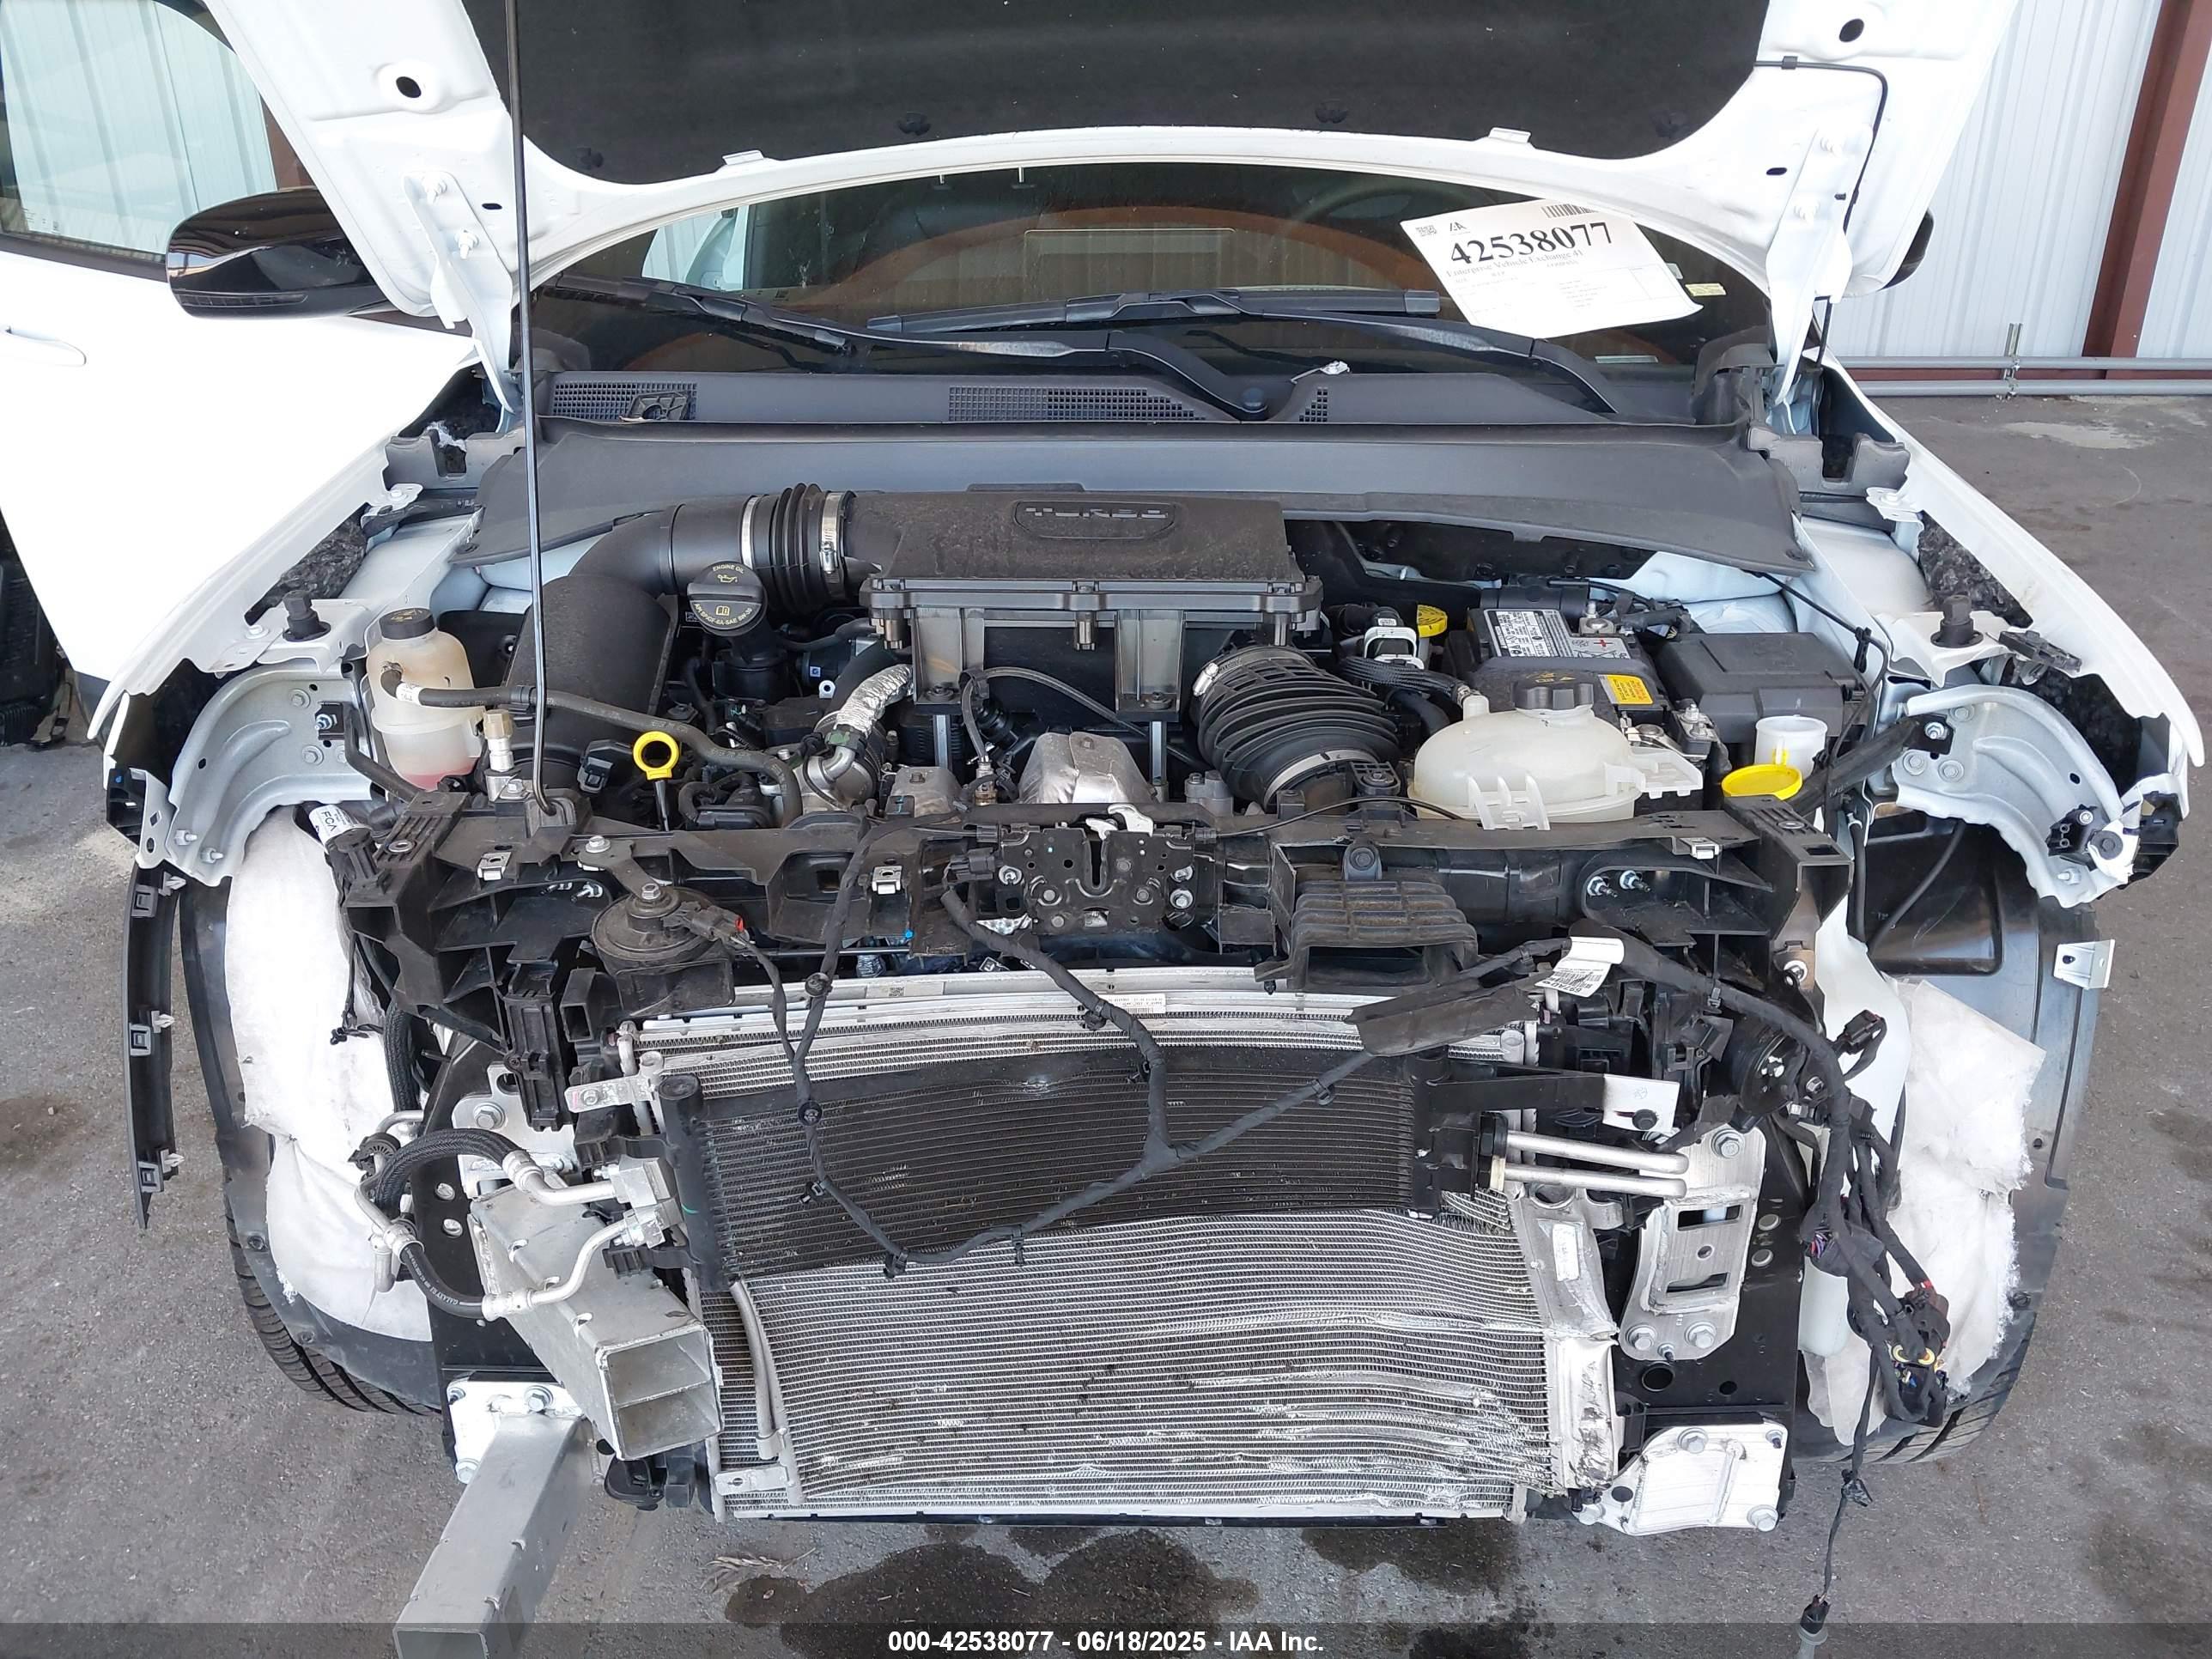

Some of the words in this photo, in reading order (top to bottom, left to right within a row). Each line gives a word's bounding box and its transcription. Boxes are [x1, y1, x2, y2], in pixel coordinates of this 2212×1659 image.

[1451, 222, 1613, 264] 42538077
[1493, 258, 1528, 269] Vehicle
[1528, 252, 1571, 264] Exchange
[713, 563, 735, 572] ENGINE
